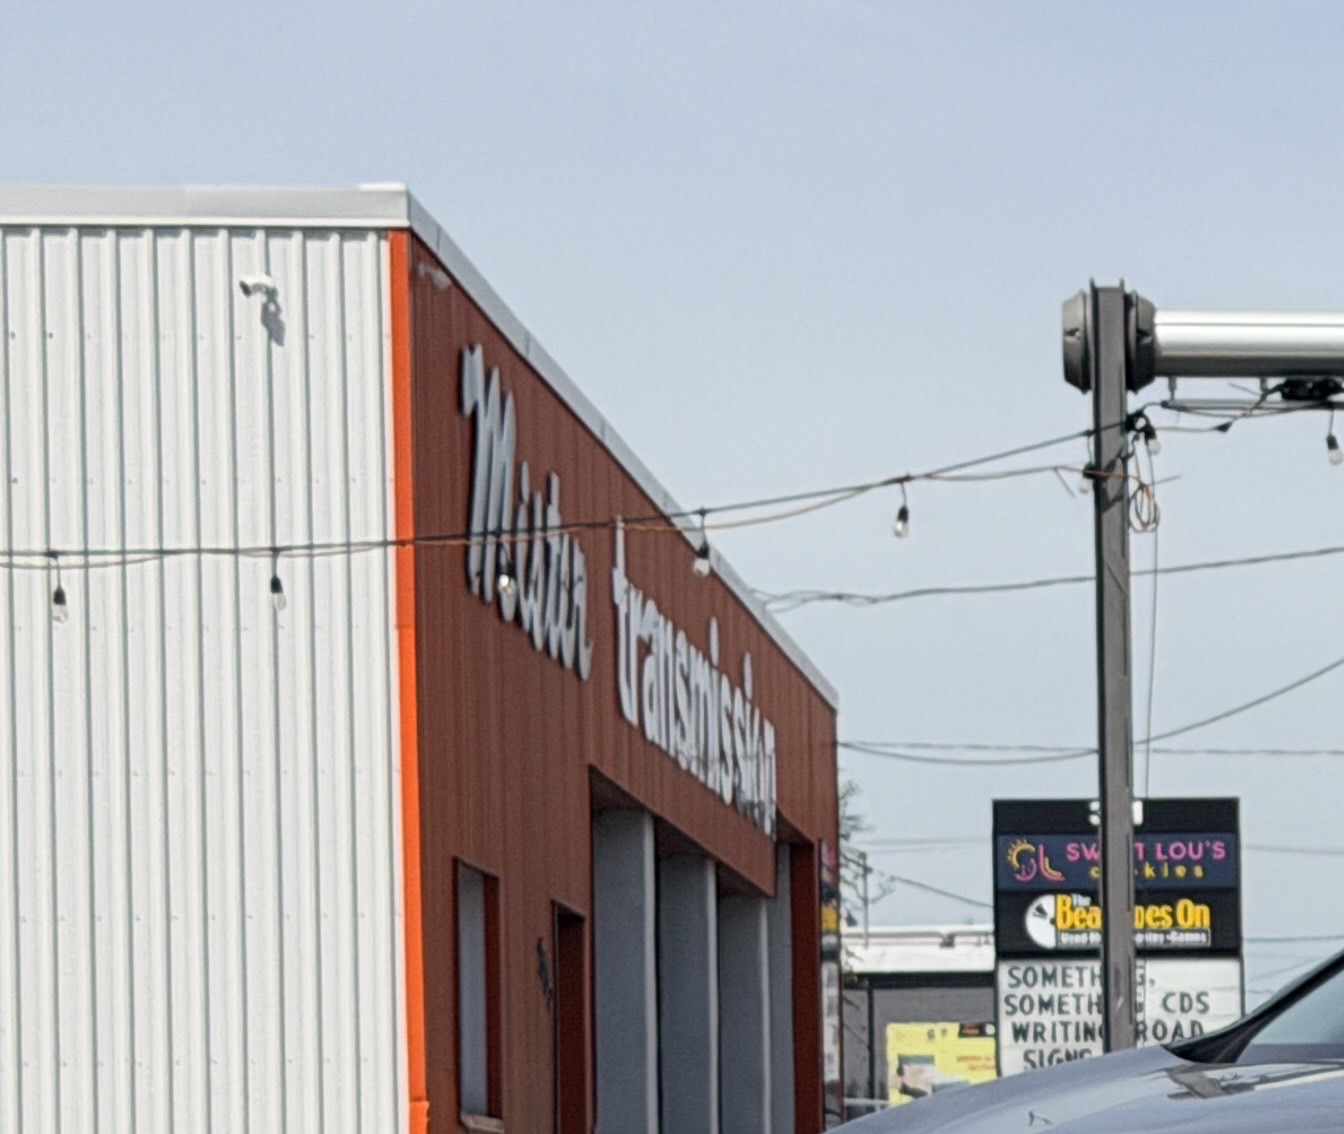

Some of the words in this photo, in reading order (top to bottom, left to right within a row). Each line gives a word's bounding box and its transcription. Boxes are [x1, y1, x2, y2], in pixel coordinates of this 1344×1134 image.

[613, 514, 778, 842] transmission
[1066, 842, 1145, 861] SWT
[1156, 840, 1226, 861] LOU'S
[1089, 861, 1204, 879] ckies
[1056, 894, 1102, 930] Bea
[1176, 898, 1211, 930] On
[1161, 991, 1210, 1015] CDS
[1011, 1021, 1103, 1044] WRITIN
